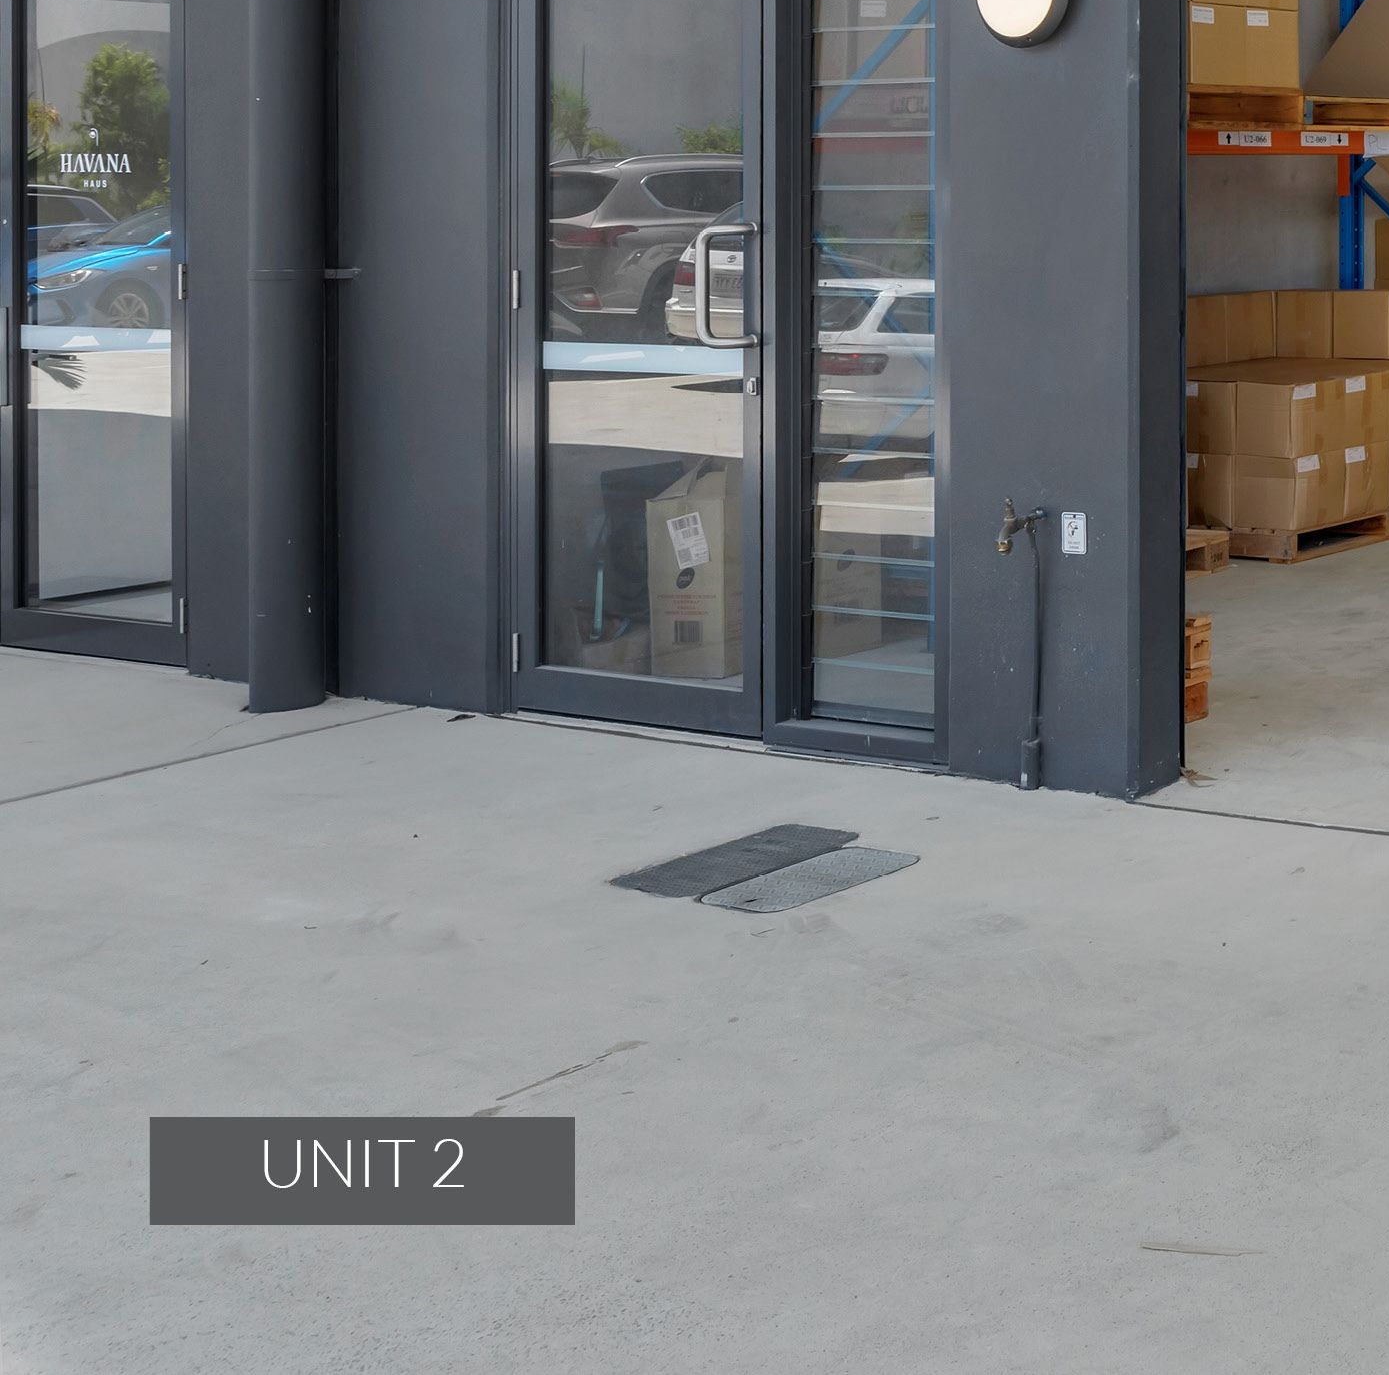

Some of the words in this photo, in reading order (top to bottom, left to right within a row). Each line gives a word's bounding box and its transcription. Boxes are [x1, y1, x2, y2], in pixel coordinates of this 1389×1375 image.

[1244, 134, 1267, 143] U2-066
[1305, 135, 1327, 143] U2-069
[60, 153, 132, 173] HAVANA
[83, 179, 107, 187] HAUS
